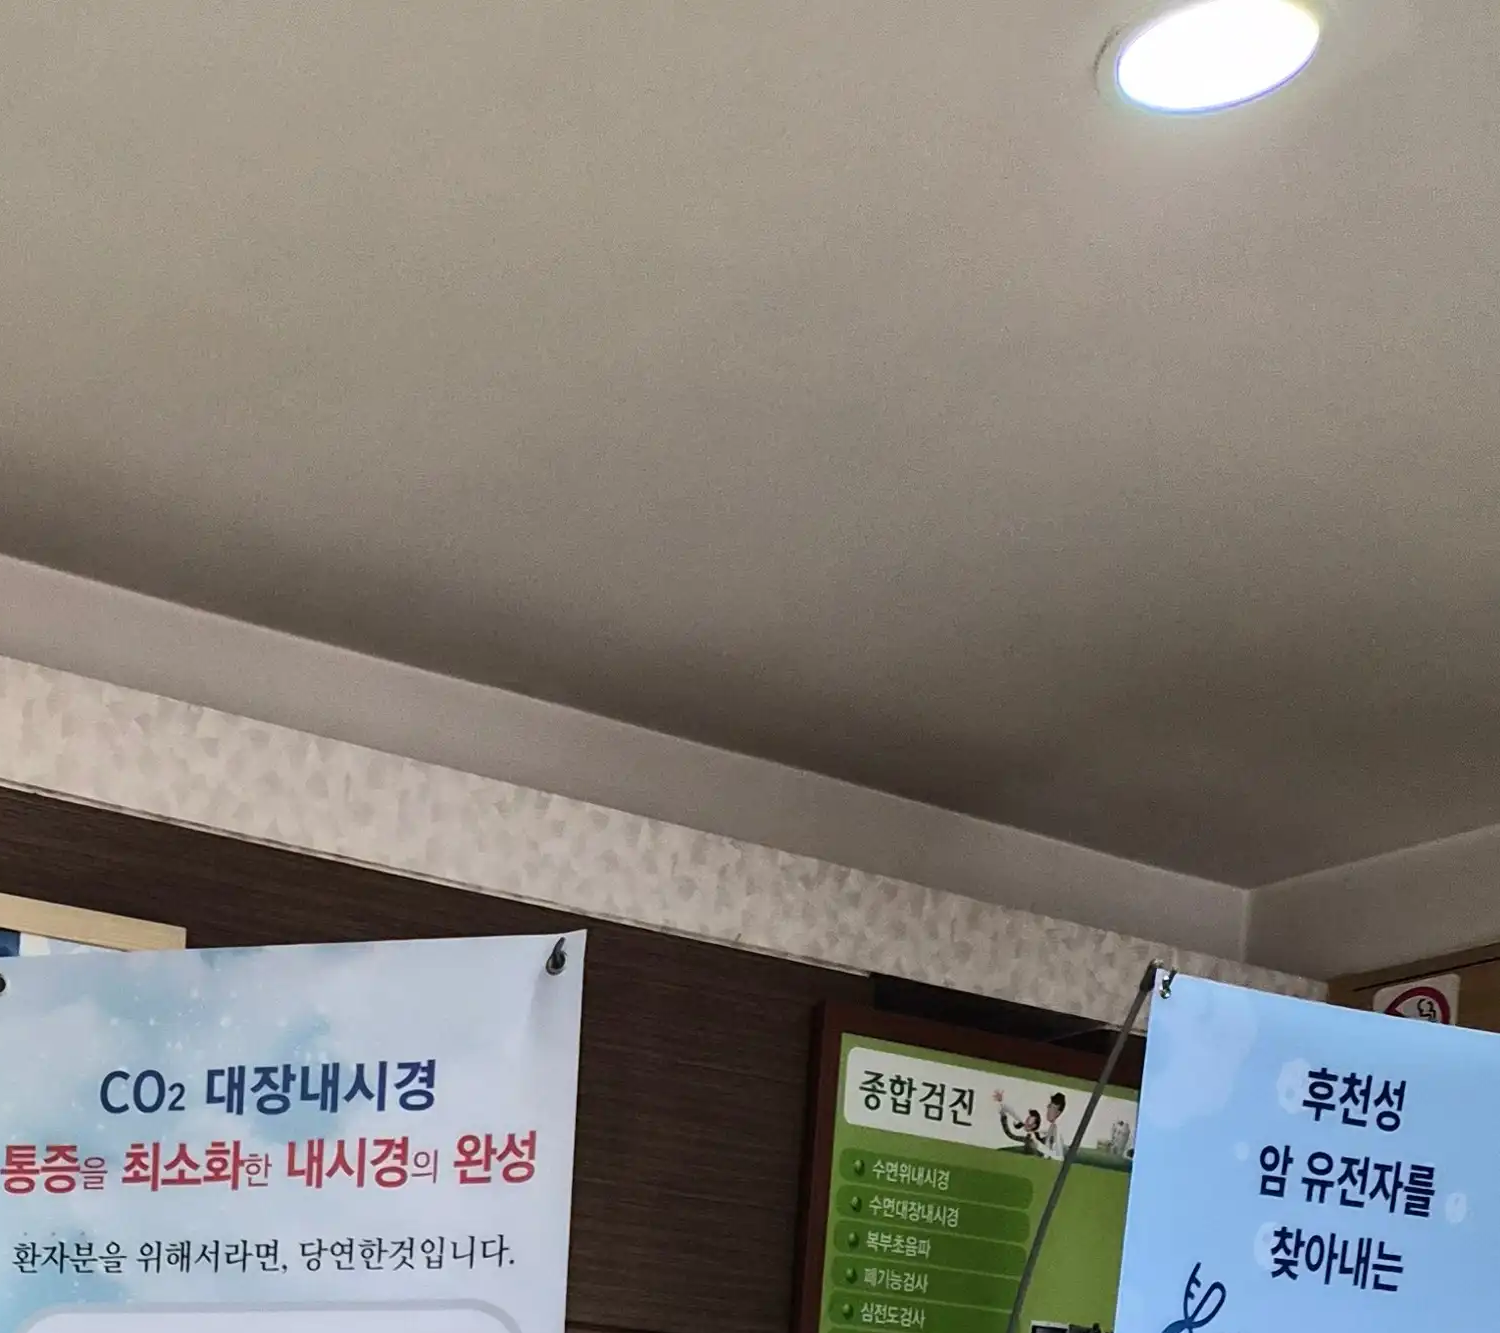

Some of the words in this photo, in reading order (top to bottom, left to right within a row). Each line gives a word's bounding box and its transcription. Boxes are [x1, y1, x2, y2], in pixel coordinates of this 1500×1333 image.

[206, 1058, 437, 1115] 대장내시경
[858, 1069, 977, 1128] 종합검진
[1302, 1066, 1407, 1133] 후천성
[0, 1143, 108, 1194] 통증을
[121, 1140, 272, 1191] 최소화한
[286, 1135, 439, 1188] 내시경의
[453, 1129, 538, 1185] 완성
[872, 1159, 951, 1191] 수면위내시경
[1258, 1144, 1294, 1198] 암
[1302, 1150, 1437, 1218] 유전자를
[868, 1195, 960, 1229] 수면대장내시경
[12, 1240, 127, 1275] 환자분을
[136, 1237, 288, 1275] 위해서라면,
[298, 1234, 516, 1273] 당연한것입니다.
[865, 1230, 932, 1258] 복부초음파
[1269, 1225, 1406, 1293] 찾아내는
[859, 1301, 927, 1329] 심전도검사
